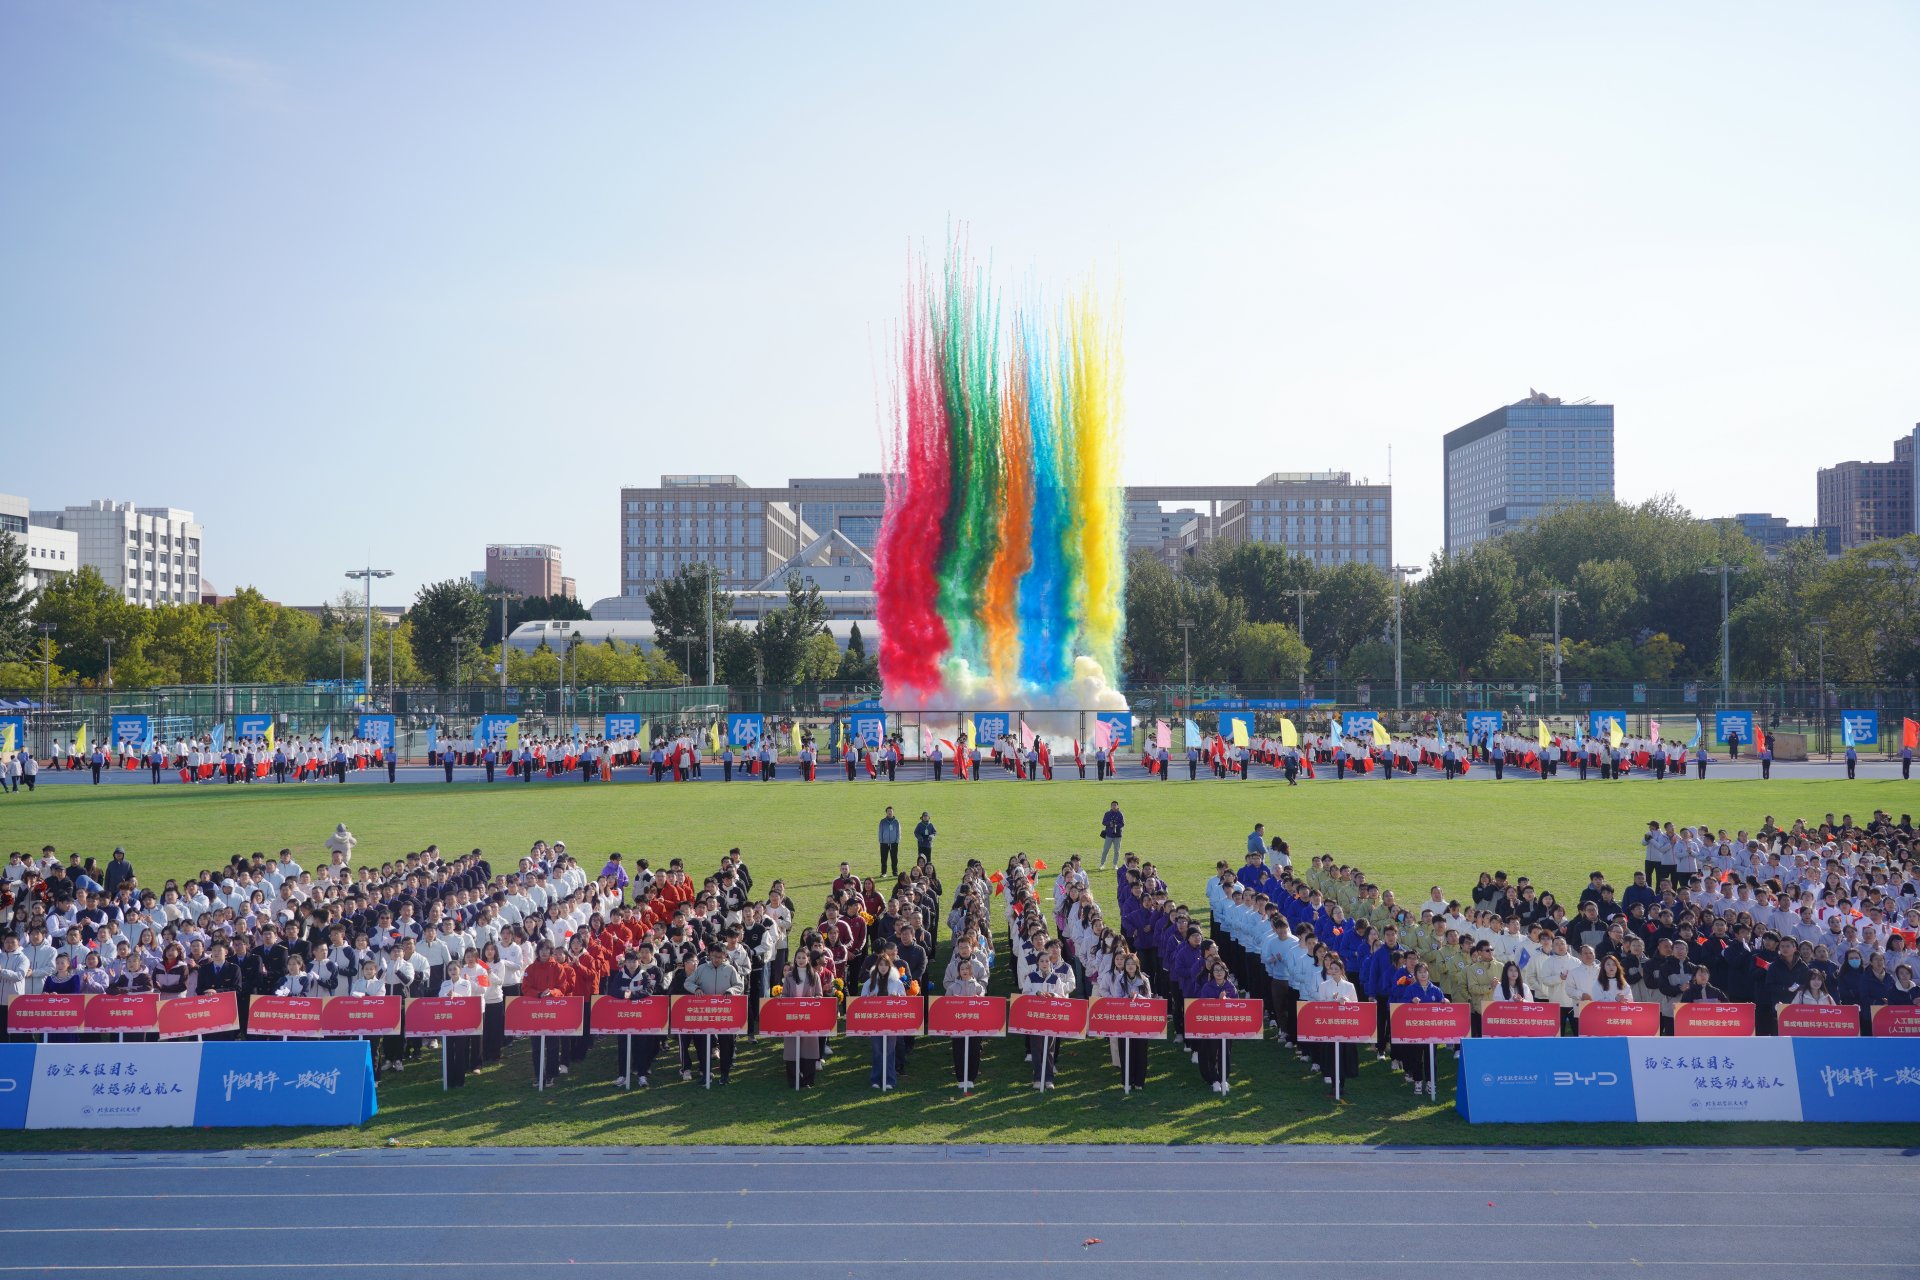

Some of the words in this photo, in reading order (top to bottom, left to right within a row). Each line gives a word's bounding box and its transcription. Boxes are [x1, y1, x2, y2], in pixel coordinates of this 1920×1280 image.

[117, 720, 143, 748] 受
[610, 719, 636, 742] 强
[732, 718, 758, 745] 体
[978, 717, 1005, 744] 健
[1720, 715, 1748, 741] 意
[1848, 715, 1873, 741] 志
[223, 1070, 280, 1102] 中国青年
[283, 1067, 341, 1095] 一路向前
[1553, 1071, 1618, 1086] BYD
[1820, 1065, 1878, 1097] 中国青年
